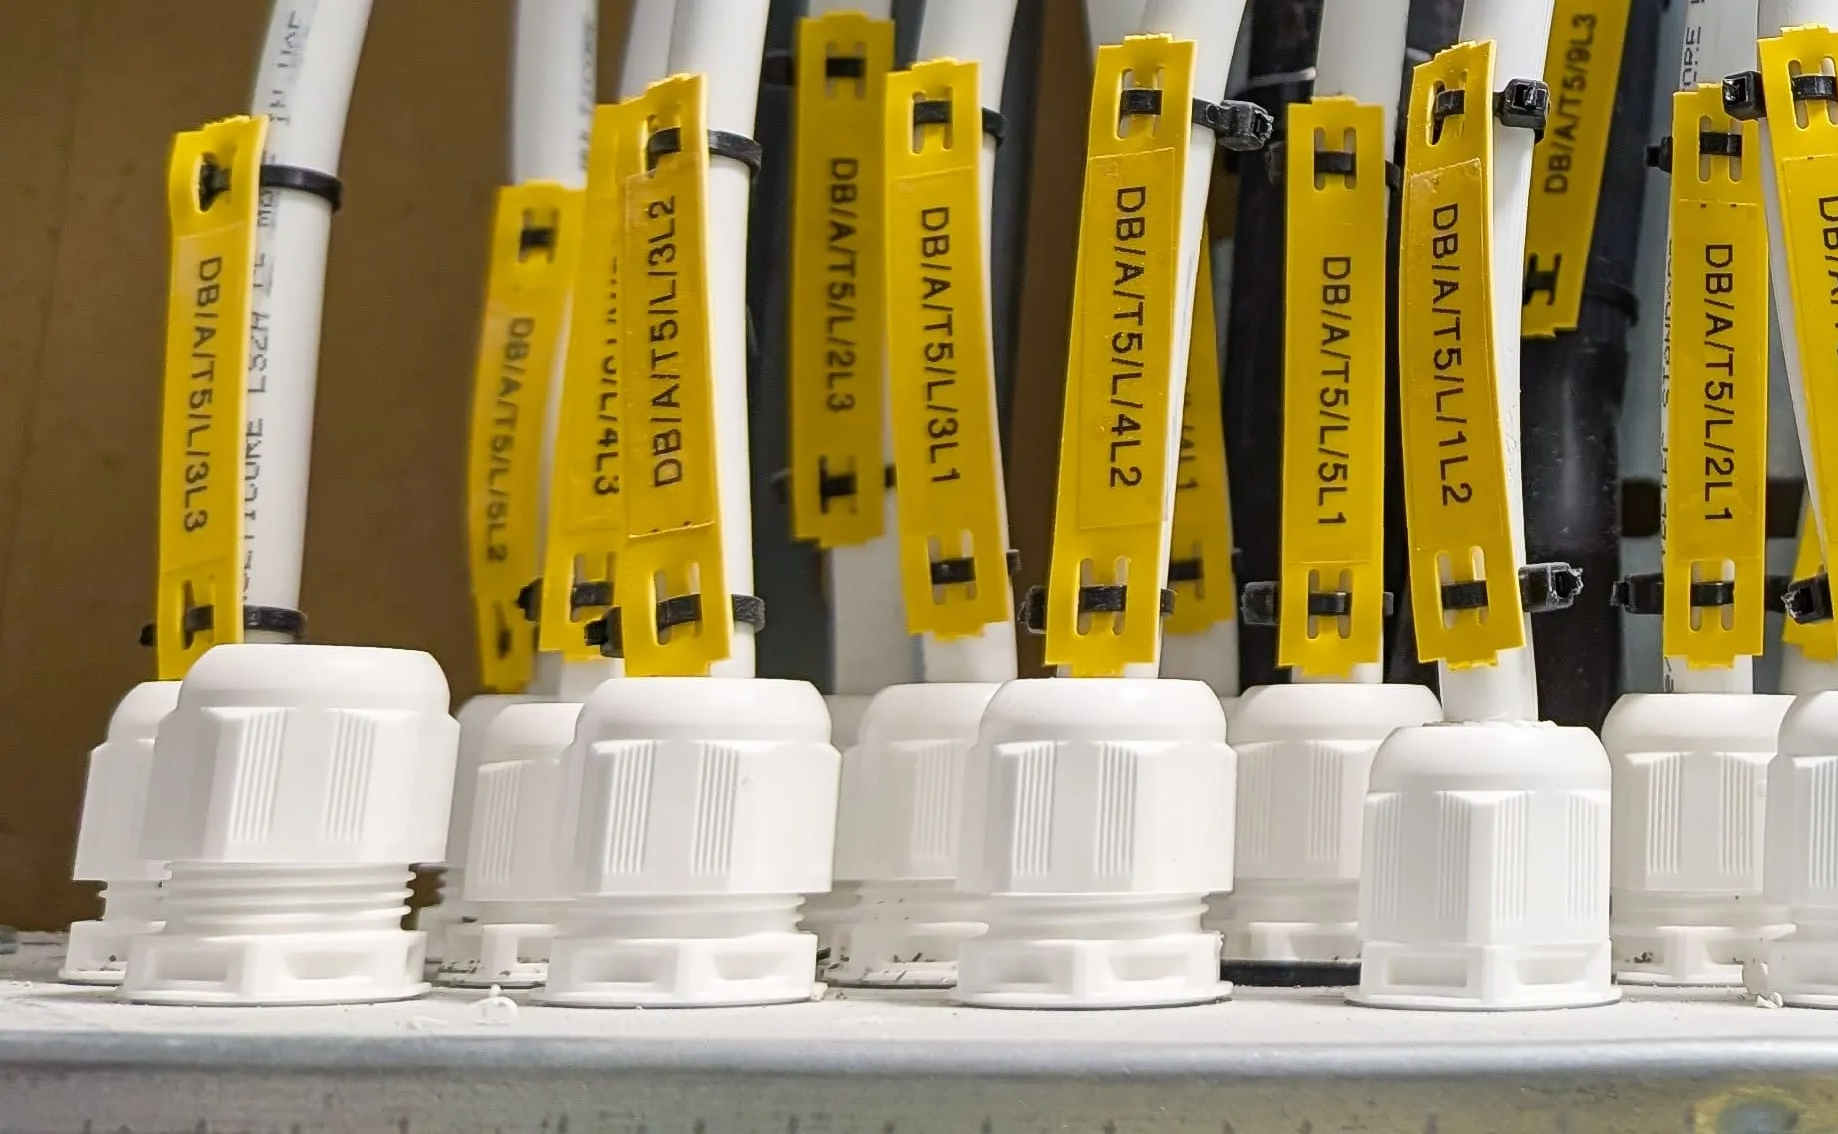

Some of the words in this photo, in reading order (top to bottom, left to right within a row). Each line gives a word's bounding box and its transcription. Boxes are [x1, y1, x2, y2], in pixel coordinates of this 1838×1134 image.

[1543, 13, 1597, 196] DB/A/T5/9L3
[182, 255, 223, 534] DB/A/T5/L/3L3
[647, 193, 683, 488] DB/A/T5/L/3L2
[826, 157, 858, 412] DB/A/T5/L/2L3
[920, 205, 961, 483] DB/A/T5/L/3L1
[1108, 186, 1145, 489] DB/A/T5/L/4L2
[1317, 256, 1351, 525] DB/A/T5/L/5L1
[1431, 203, 1473, 507] DB/A/T5/L/1L2
[1704, 243, 1735, 522] DB/A/T5/L/2L1
